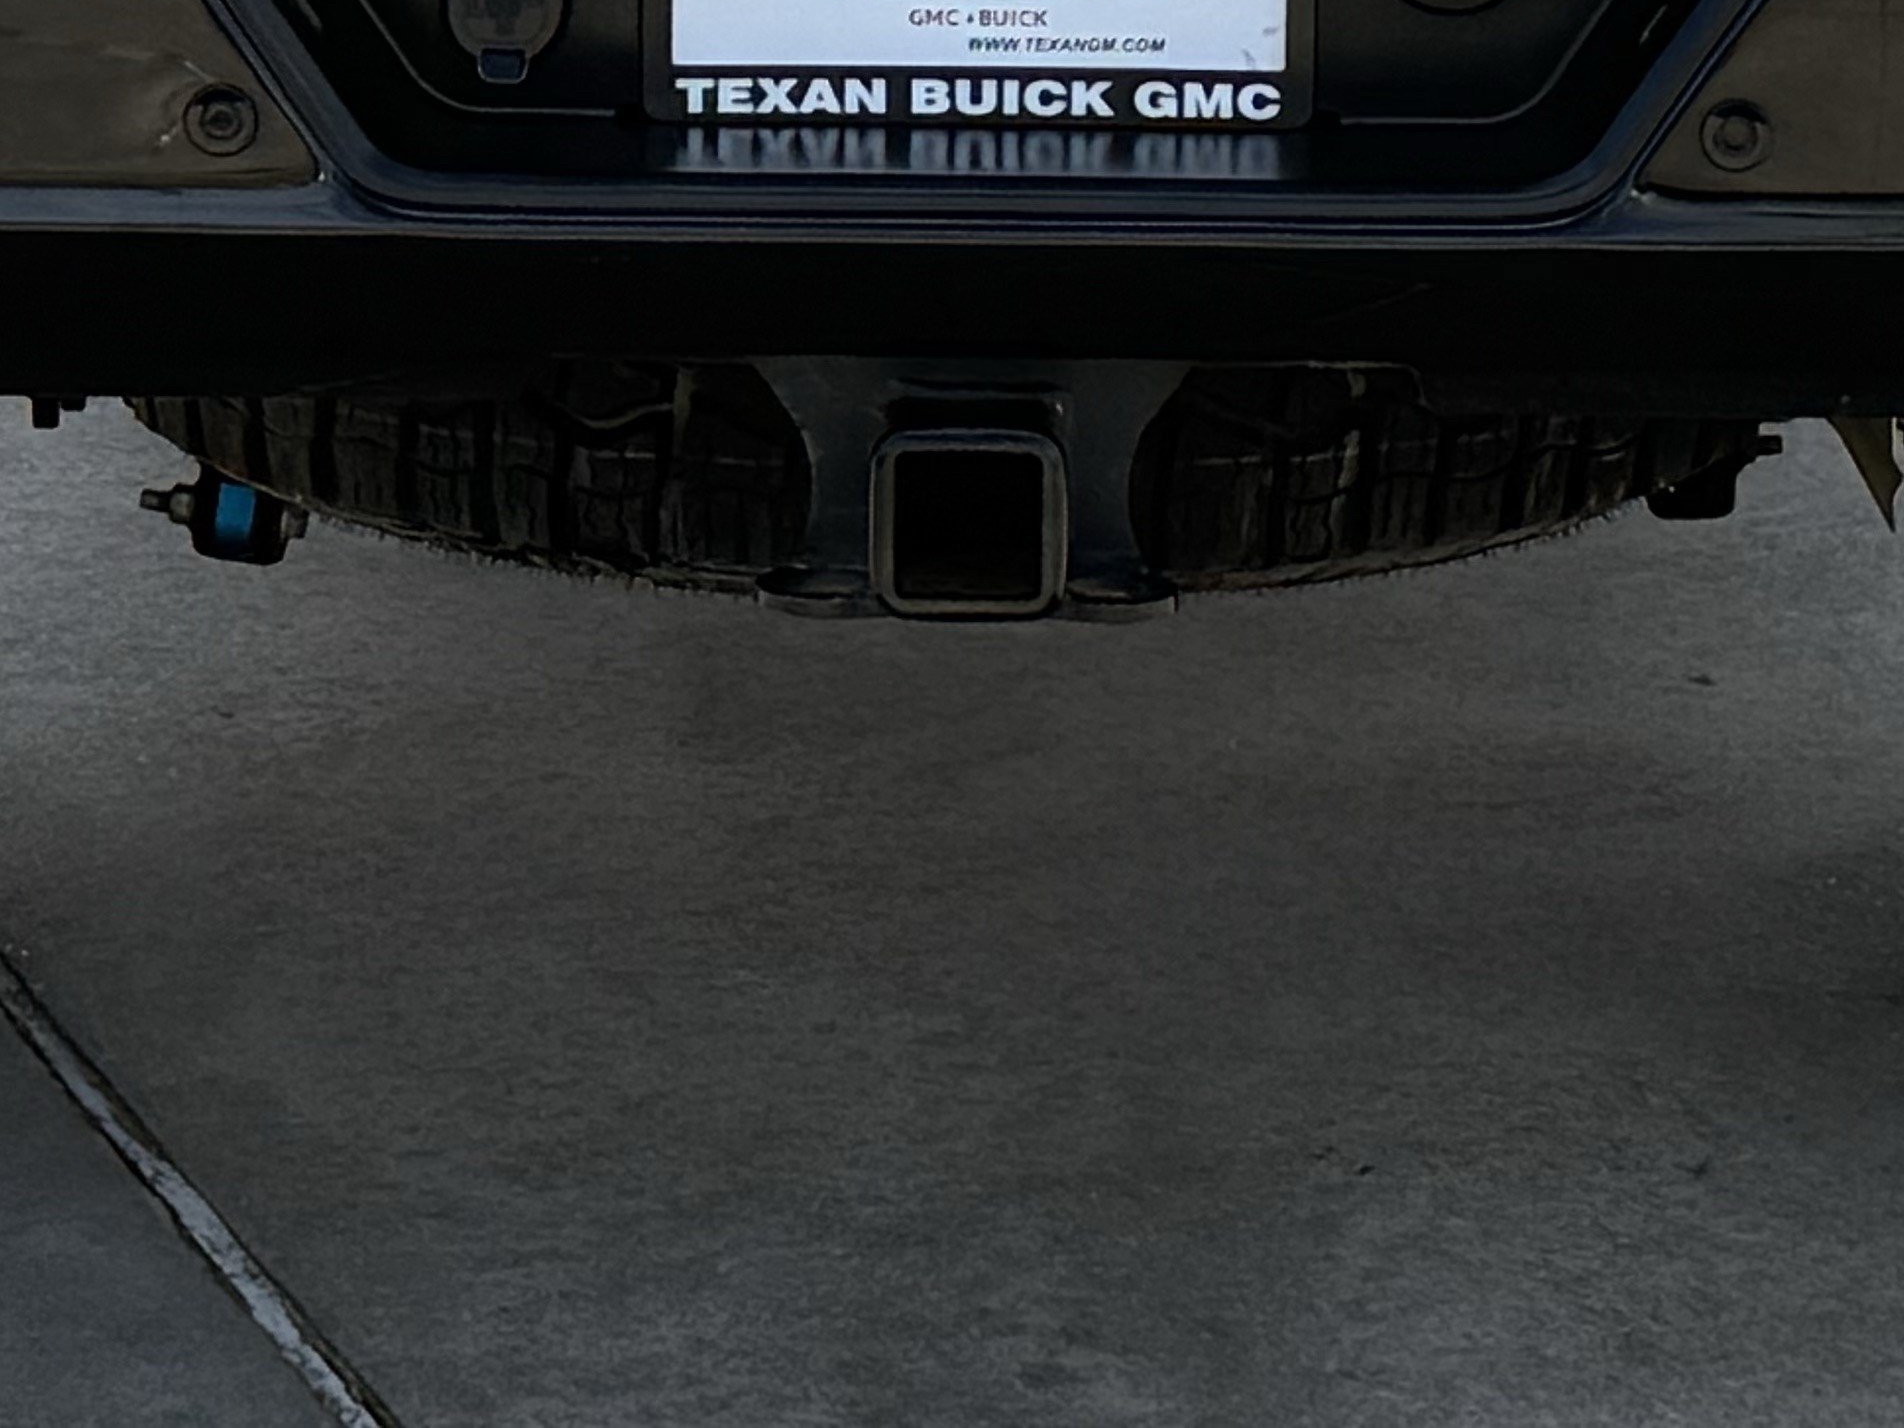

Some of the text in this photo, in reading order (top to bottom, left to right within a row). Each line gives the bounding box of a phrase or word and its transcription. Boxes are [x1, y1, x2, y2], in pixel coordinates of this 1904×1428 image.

[908, 8, 1048, 27] GMC BUICK
[675, 78, 1282, 122] TEXAN BUICK GMC
